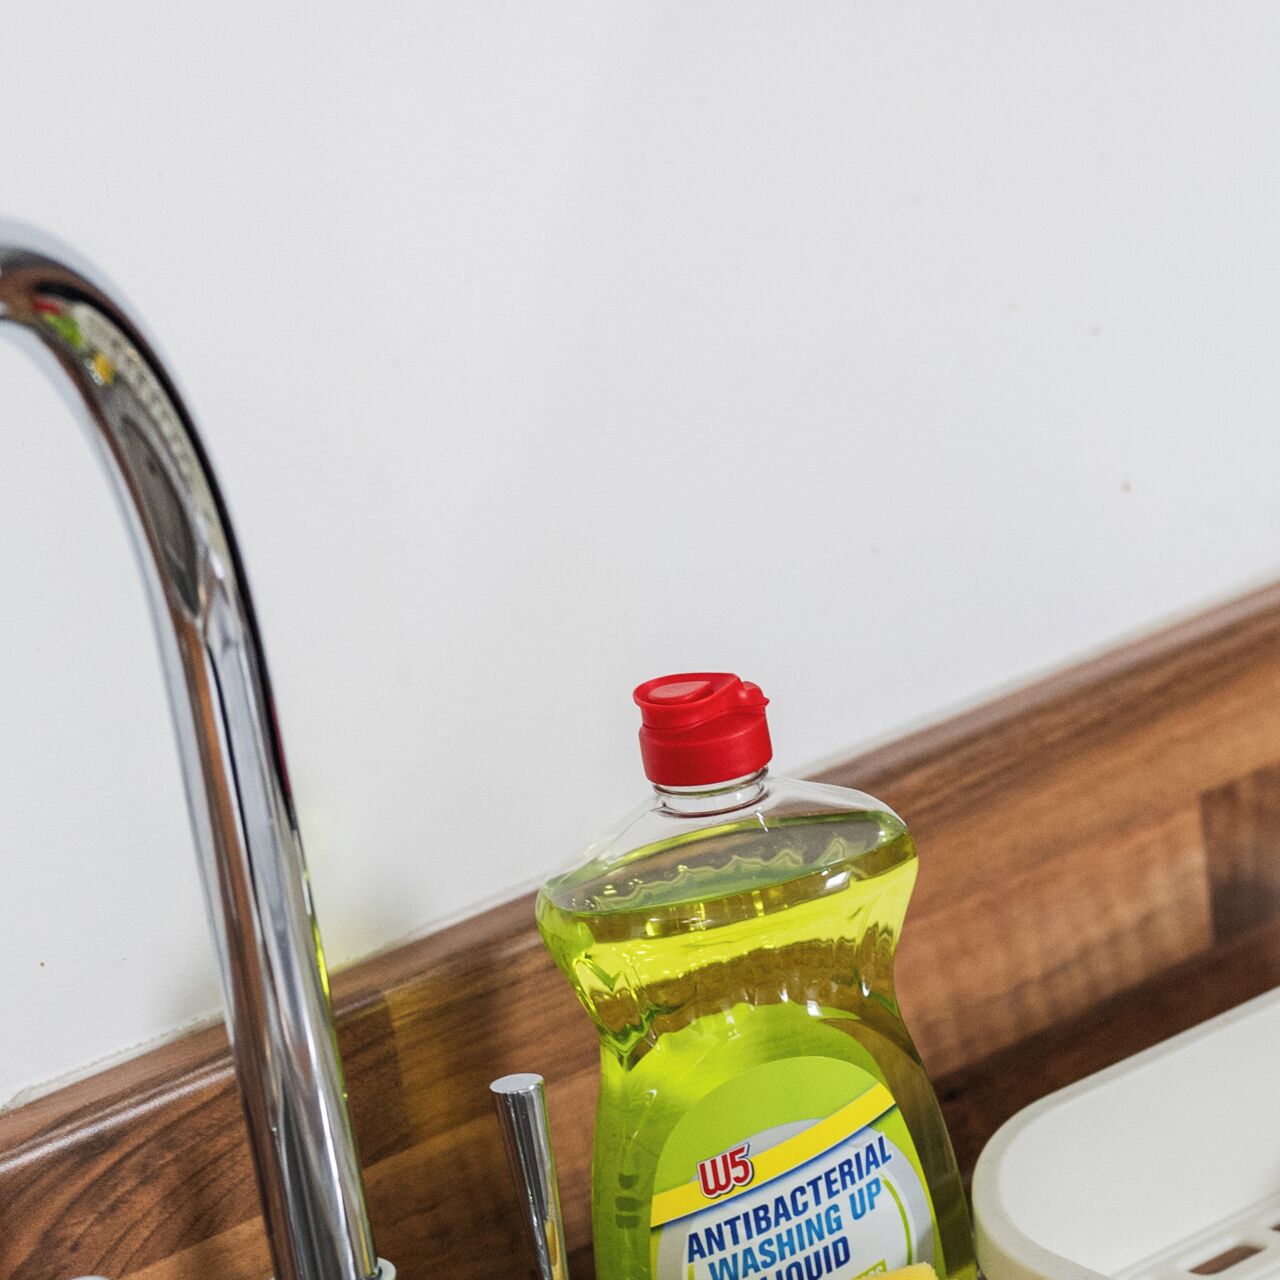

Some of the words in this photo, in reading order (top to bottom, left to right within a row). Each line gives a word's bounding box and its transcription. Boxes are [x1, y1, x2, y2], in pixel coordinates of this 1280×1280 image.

[697, 1145, 751, 1197] W5
[687, 1135, 893, 1264] ANTIBACTERIAL
[849, 1178, 882, 1221] UP
